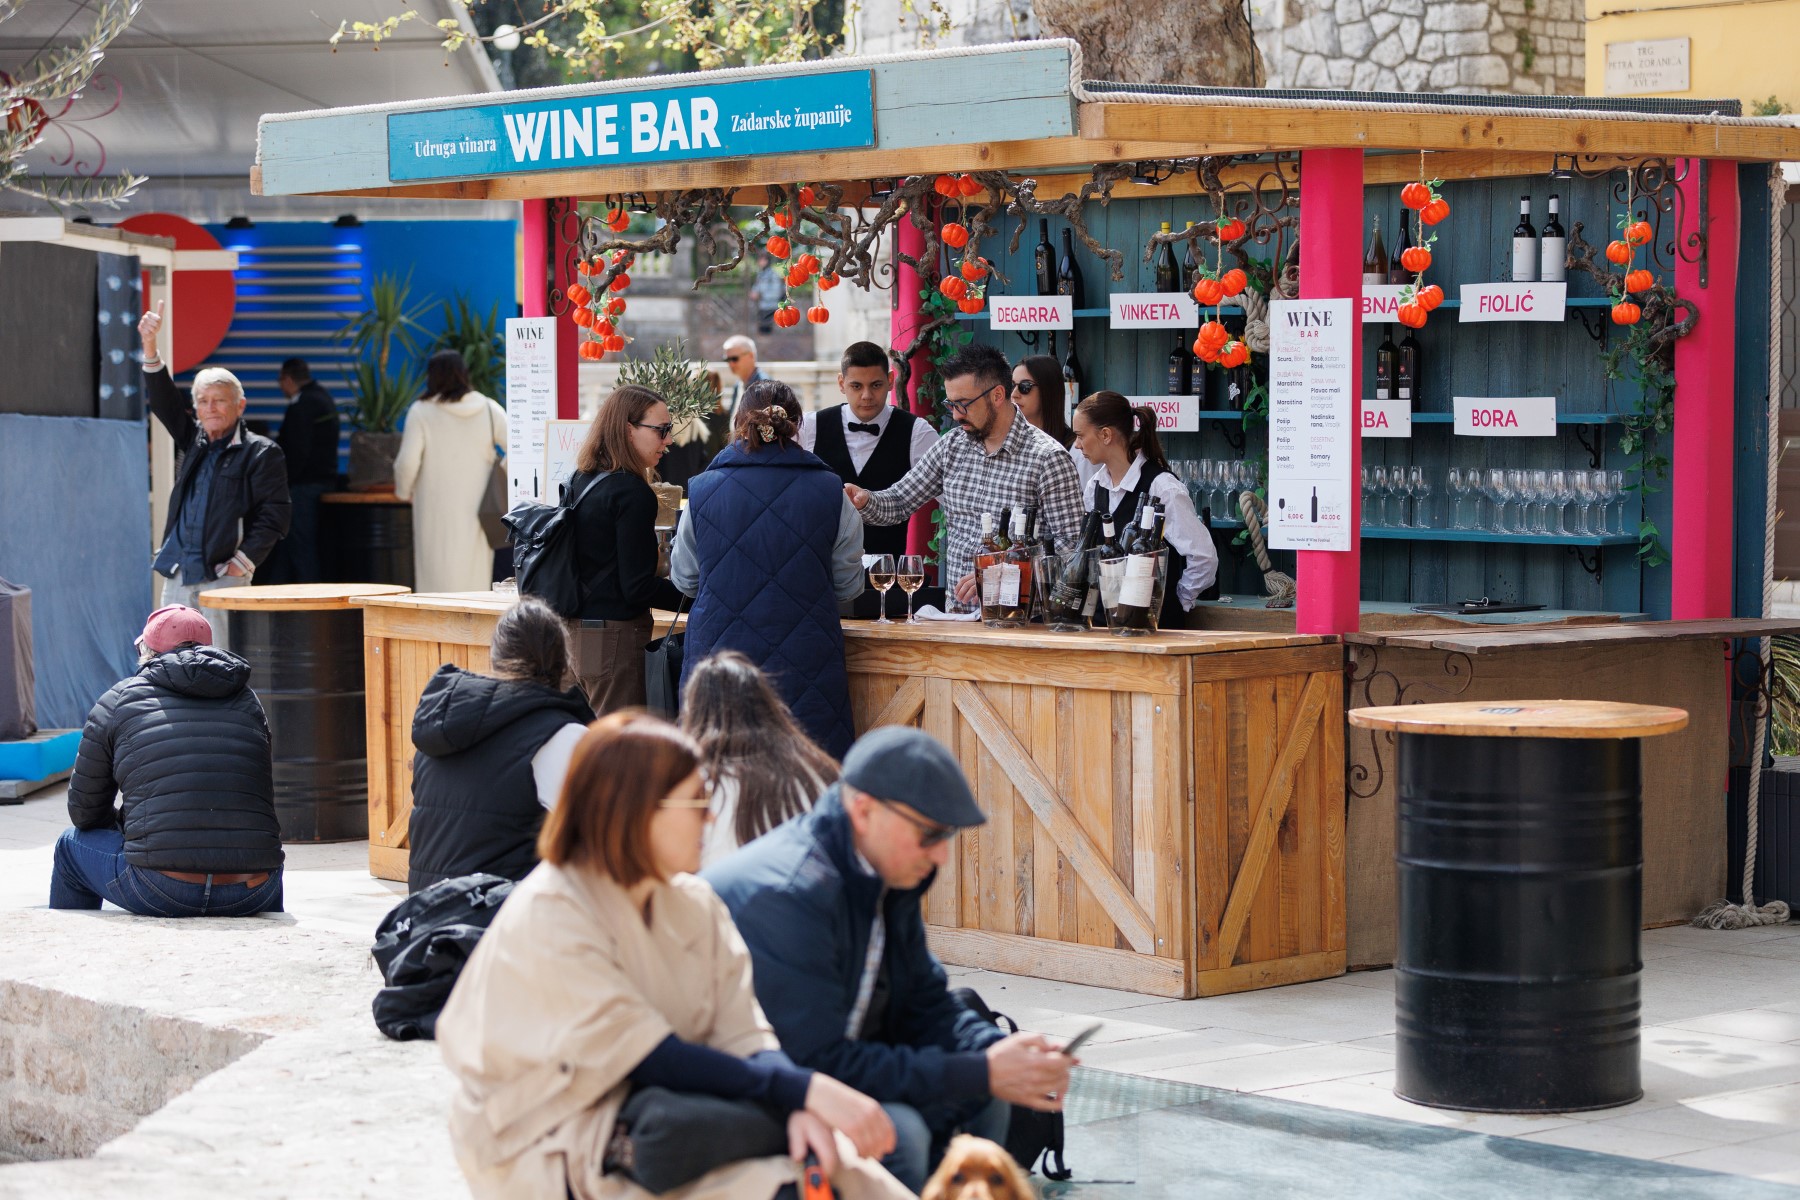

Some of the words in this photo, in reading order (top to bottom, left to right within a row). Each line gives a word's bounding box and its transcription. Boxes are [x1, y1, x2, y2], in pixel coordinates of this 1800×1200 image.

[732, 110, 791, 133] Zadarske
[795, 105, 852, 129] županije
[503, 103, 619, 163] WINE
[630, 96, 721, 154] BAR
[414, 138, 456, 159] Udruga
[459, 136, 497, 155] vinara
[1362, 297, 1398, 313] BNA
[1480, 290, 1534, 313] FIOLIĆ
[998, 306, 1060, 323] DEGARRA
[1120, 303, 1180, 321] VINKETA
[1287, 311, 1333, 327] WINE
[516, 327, 544, 340] WINE
[1300, 330, 1319, 338] BAR
[1362, 410, 1389, 428] BA
[1472, 409, 1518, 427] BORA
